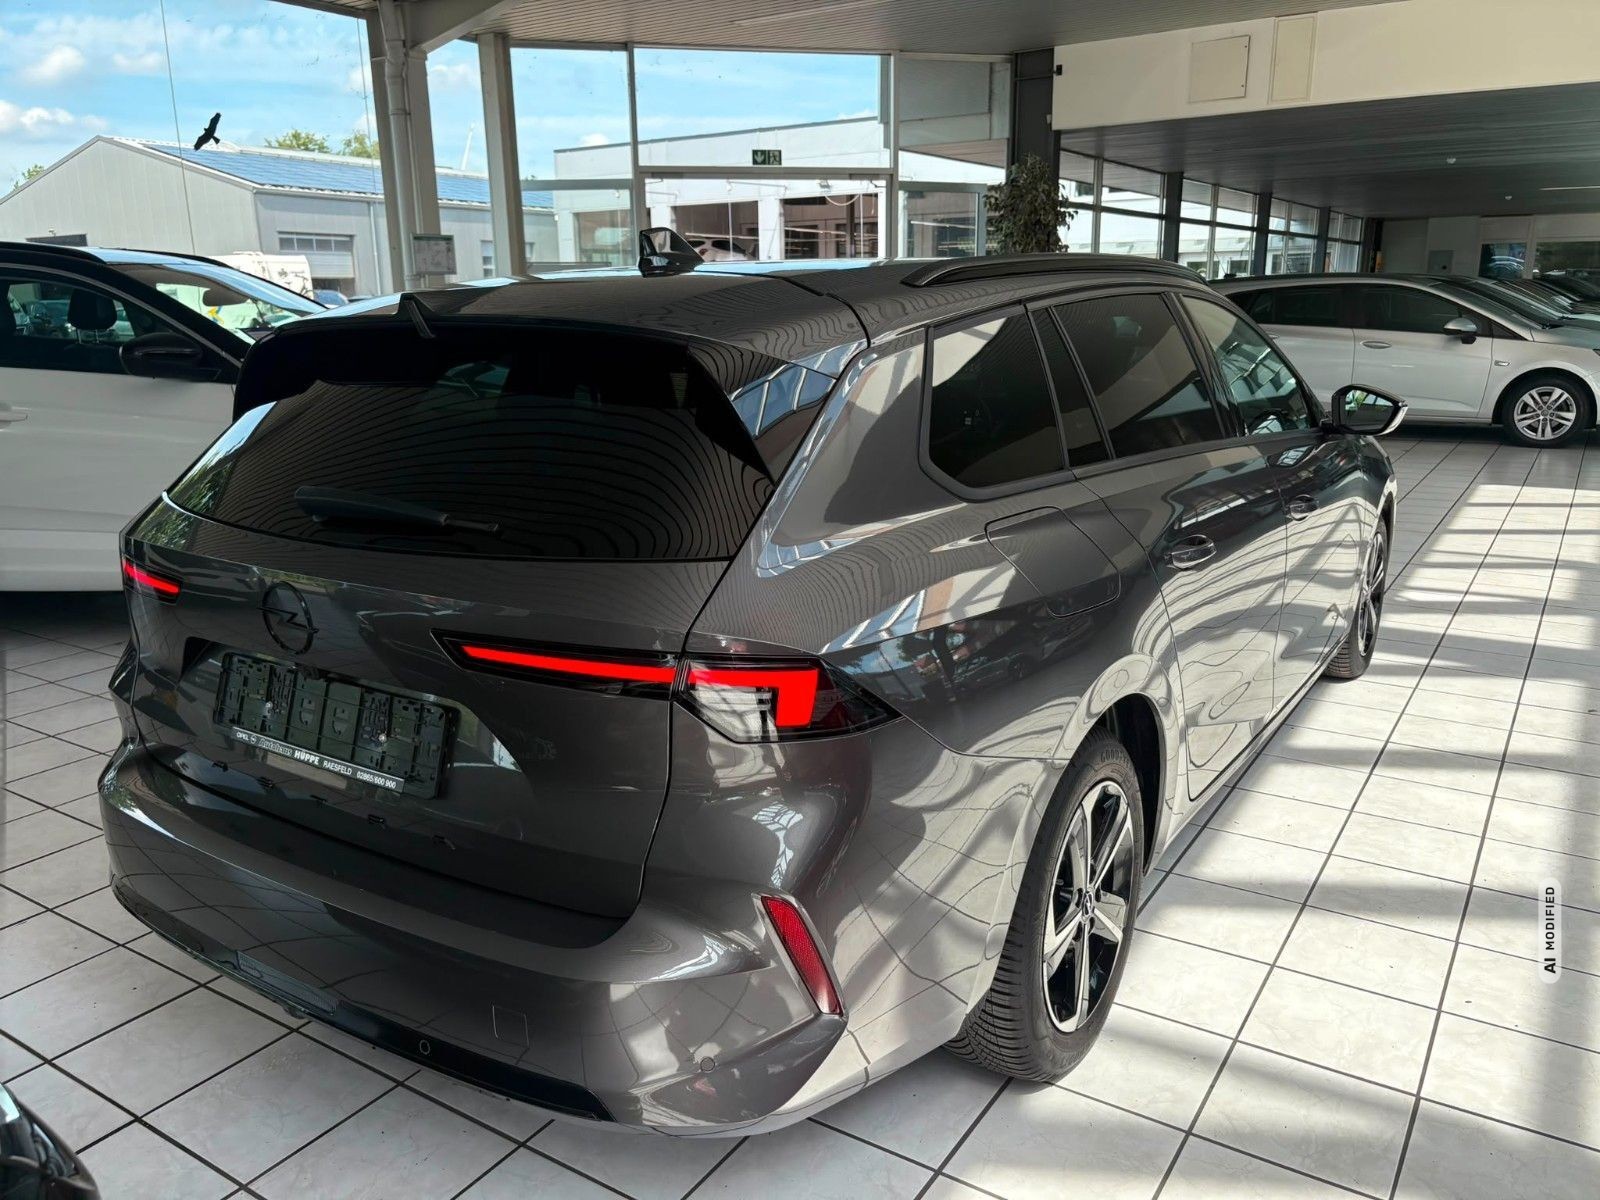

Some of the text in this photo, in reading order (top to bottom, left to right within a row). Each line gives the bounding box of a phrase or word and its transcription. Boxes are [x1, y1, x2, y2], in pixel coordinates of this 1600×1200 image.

[236, 731, 249, 741] OPEL
[294, 749, 320, 765] HÜPPE
[322, 760, 352, 776] RAESFELD
[385, 779, 397, 789] 900
